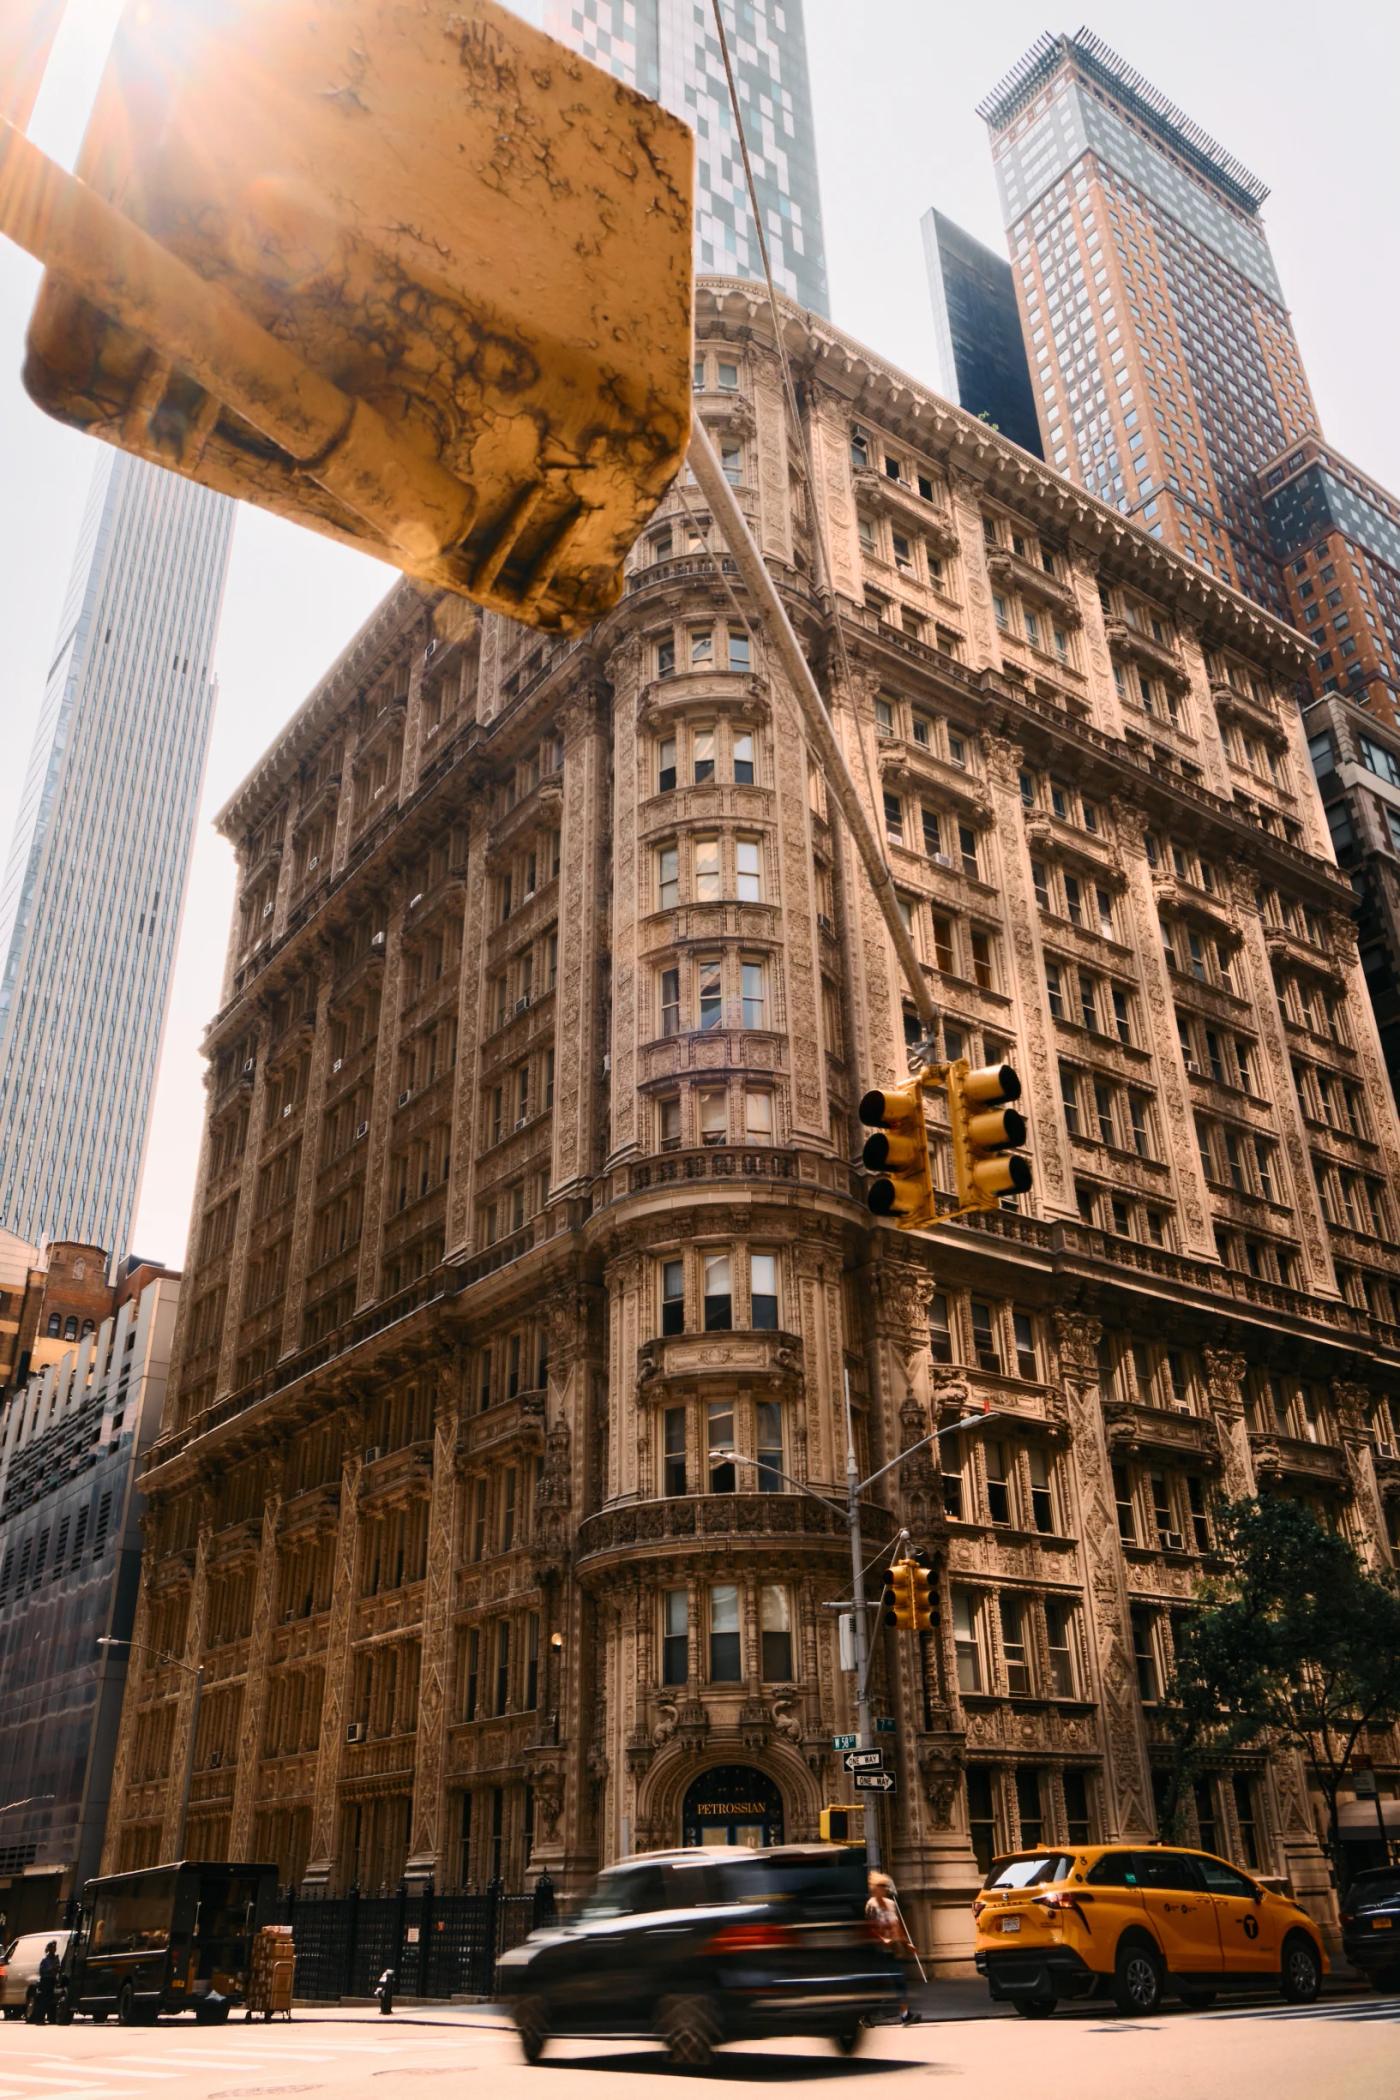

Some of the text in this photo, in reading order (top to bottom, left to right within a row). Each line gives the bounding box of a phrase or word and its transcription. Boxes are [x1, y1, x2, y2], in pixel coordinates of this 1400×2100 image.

[842, 1735, 850, 1749] 58
[848, 1755, 877, 1766] ONE WAY
[860, 1776, 889, 1786] ONE WAY
[697, 1802, 766, 1815] PETROSSIAN
[1246, 1919, 1255, 1937] T
